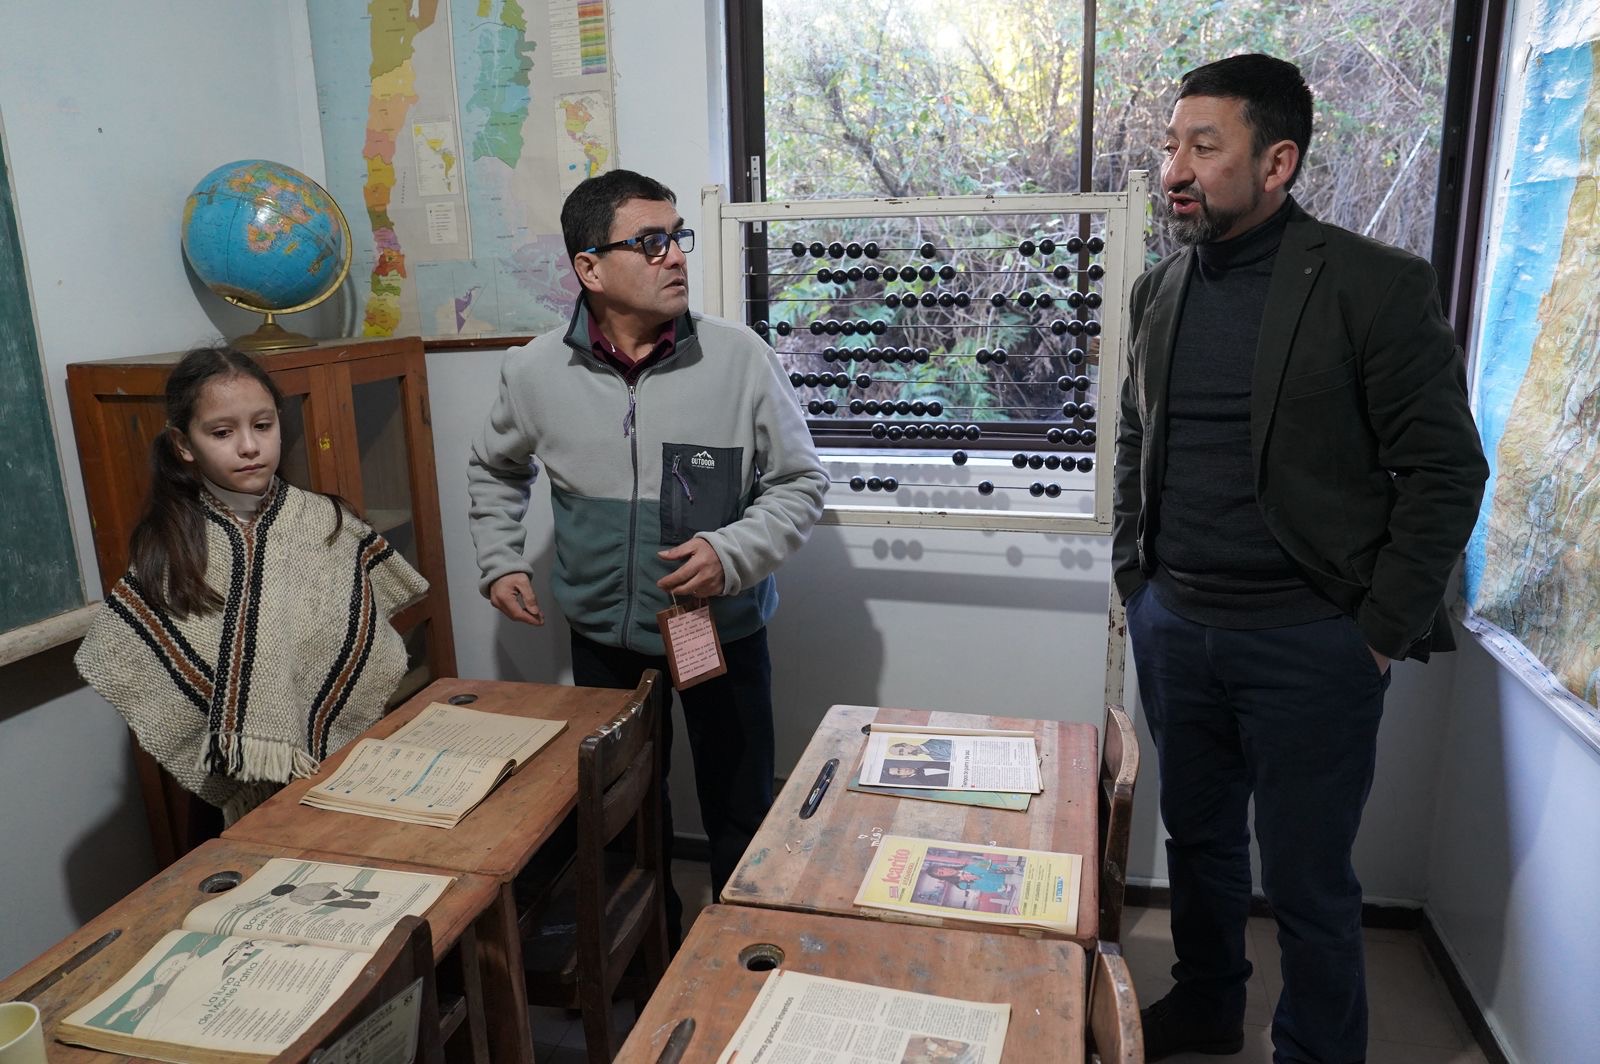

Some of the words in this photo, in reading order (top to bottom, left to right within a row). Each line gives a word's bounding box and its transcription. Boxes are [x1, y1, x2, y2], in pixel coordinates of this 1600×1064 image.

[881, 849, 910, 884] Icarito
[198, 1013, 213, 1025] de
[208, 988, 238, 1013] Monte
[233, 962, 258, 987] Patria
[202, 996, 218, 1007] La
[213, 977, 235, 996] luna
